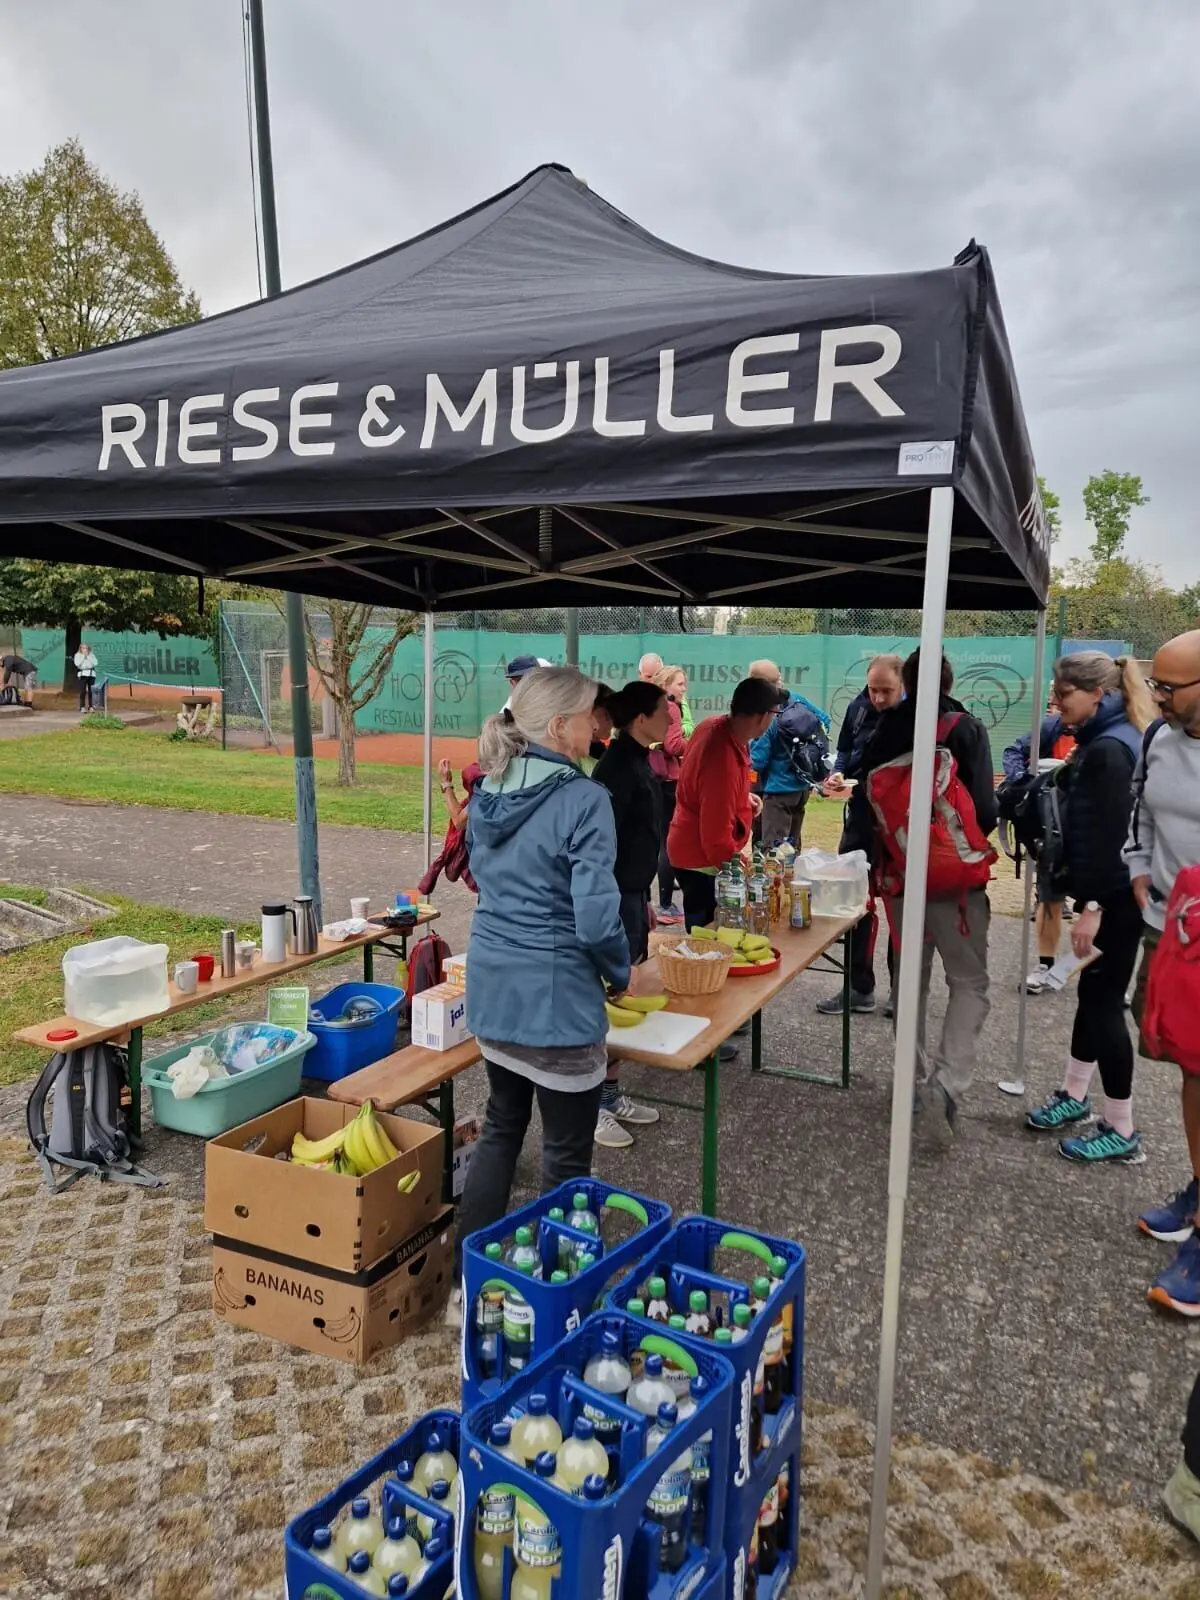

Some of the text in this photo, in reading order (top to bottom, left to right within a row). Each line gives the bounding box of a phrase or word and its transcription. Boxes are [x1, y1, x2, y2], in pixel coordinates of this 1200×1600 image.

[98, 323, 905, 471] RIESE & MÜLLER
[374, 707, 462, 730] RESTAUANT
[450, 1003, 465, 1028] ja!
[396, 1228, 435, 1265] BANANAS
[245, 1267, 325, 1306] BANANAS
